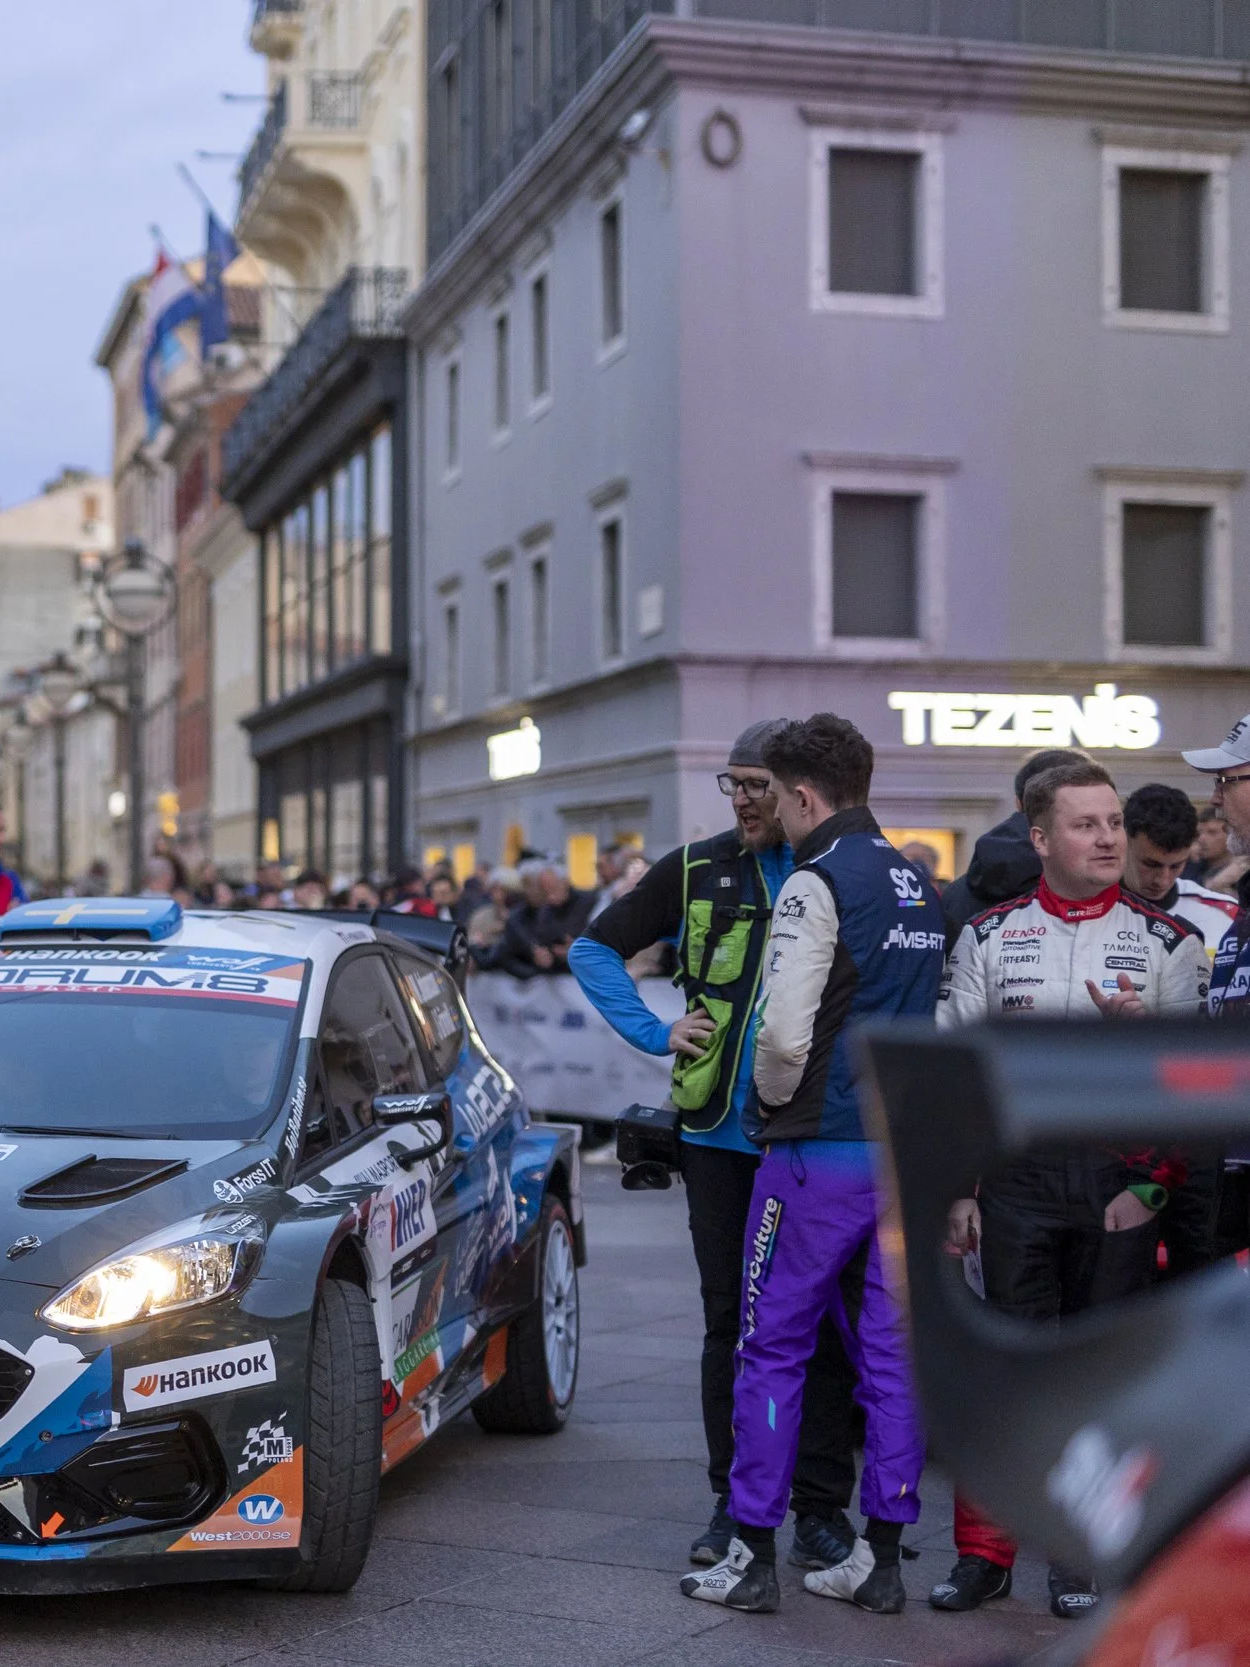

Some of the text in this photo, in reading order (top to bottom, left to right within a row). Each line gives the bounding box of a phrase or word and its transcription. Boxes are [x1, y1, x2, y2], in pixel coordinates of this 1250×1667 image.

[889, 867, 923, 900] SC
[1001, 926, 1047, 939] DENSO
[1151, 921, 1177, 942] OMP
[1006, 976, 1046, 985] McKelvey
[266, 1439, 284, 1456] M
[244, 1498, 281, 1521] W
[190, 1530, 291, 1543] West2000.se
